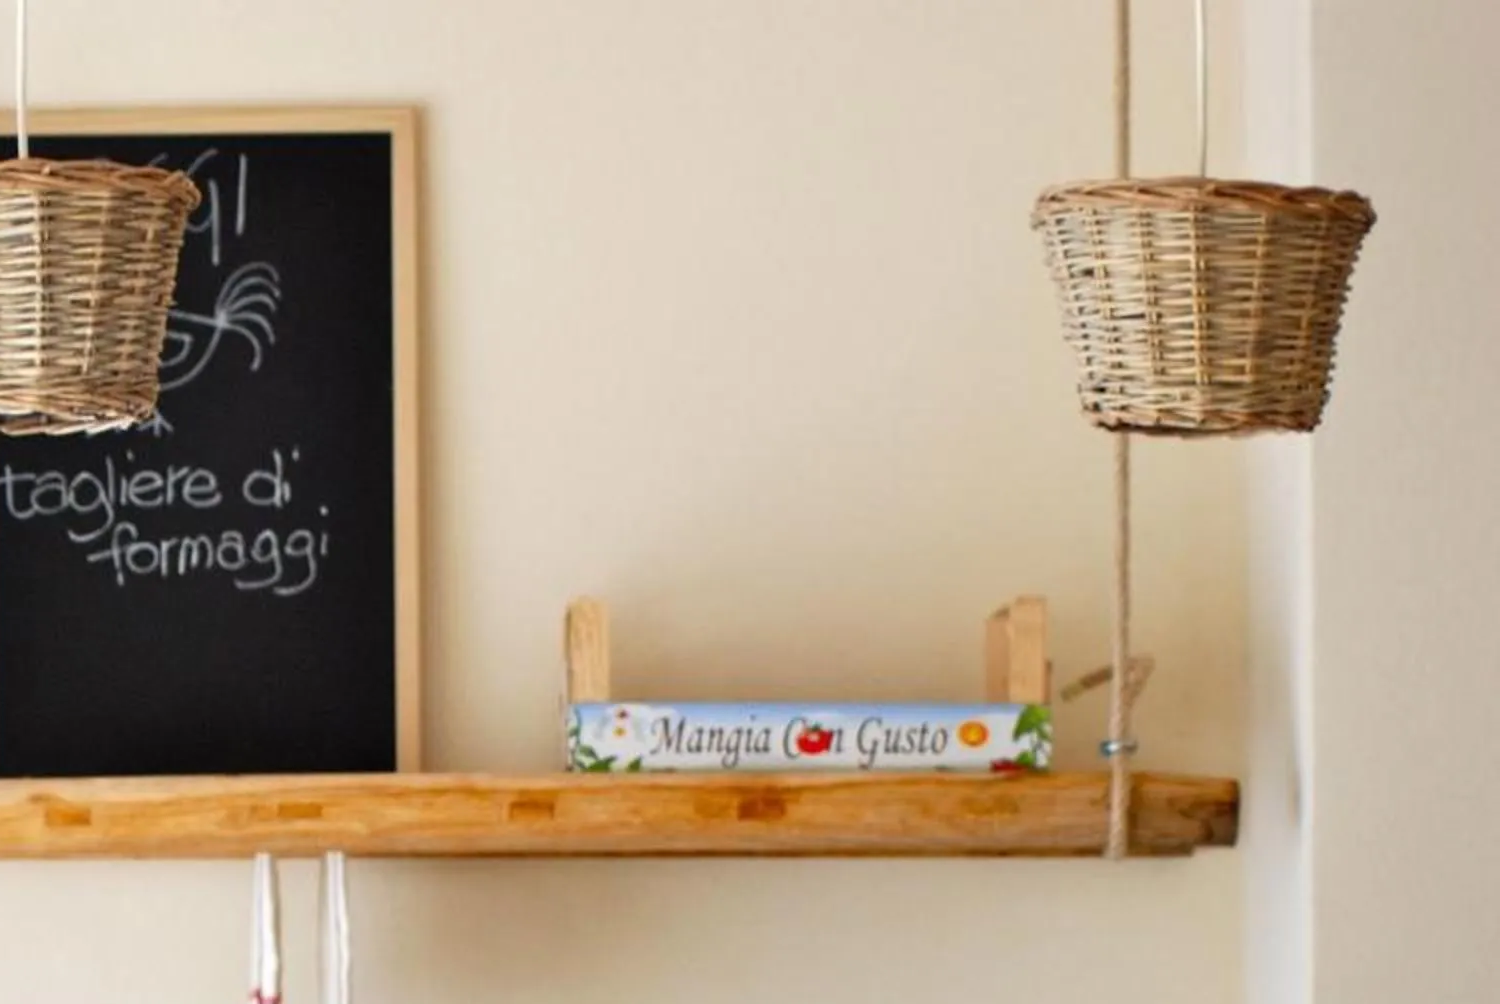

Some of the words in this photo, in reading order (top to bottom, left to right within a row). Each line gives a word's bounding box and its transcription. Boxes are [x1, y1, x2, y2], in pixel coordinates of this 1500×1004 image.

[243, 448, 300, 508] di
[87, 506, 329, 595] formaggi
[649, 714, 772, 769] Mangia
[855, 716, 950, 771] Gusto
